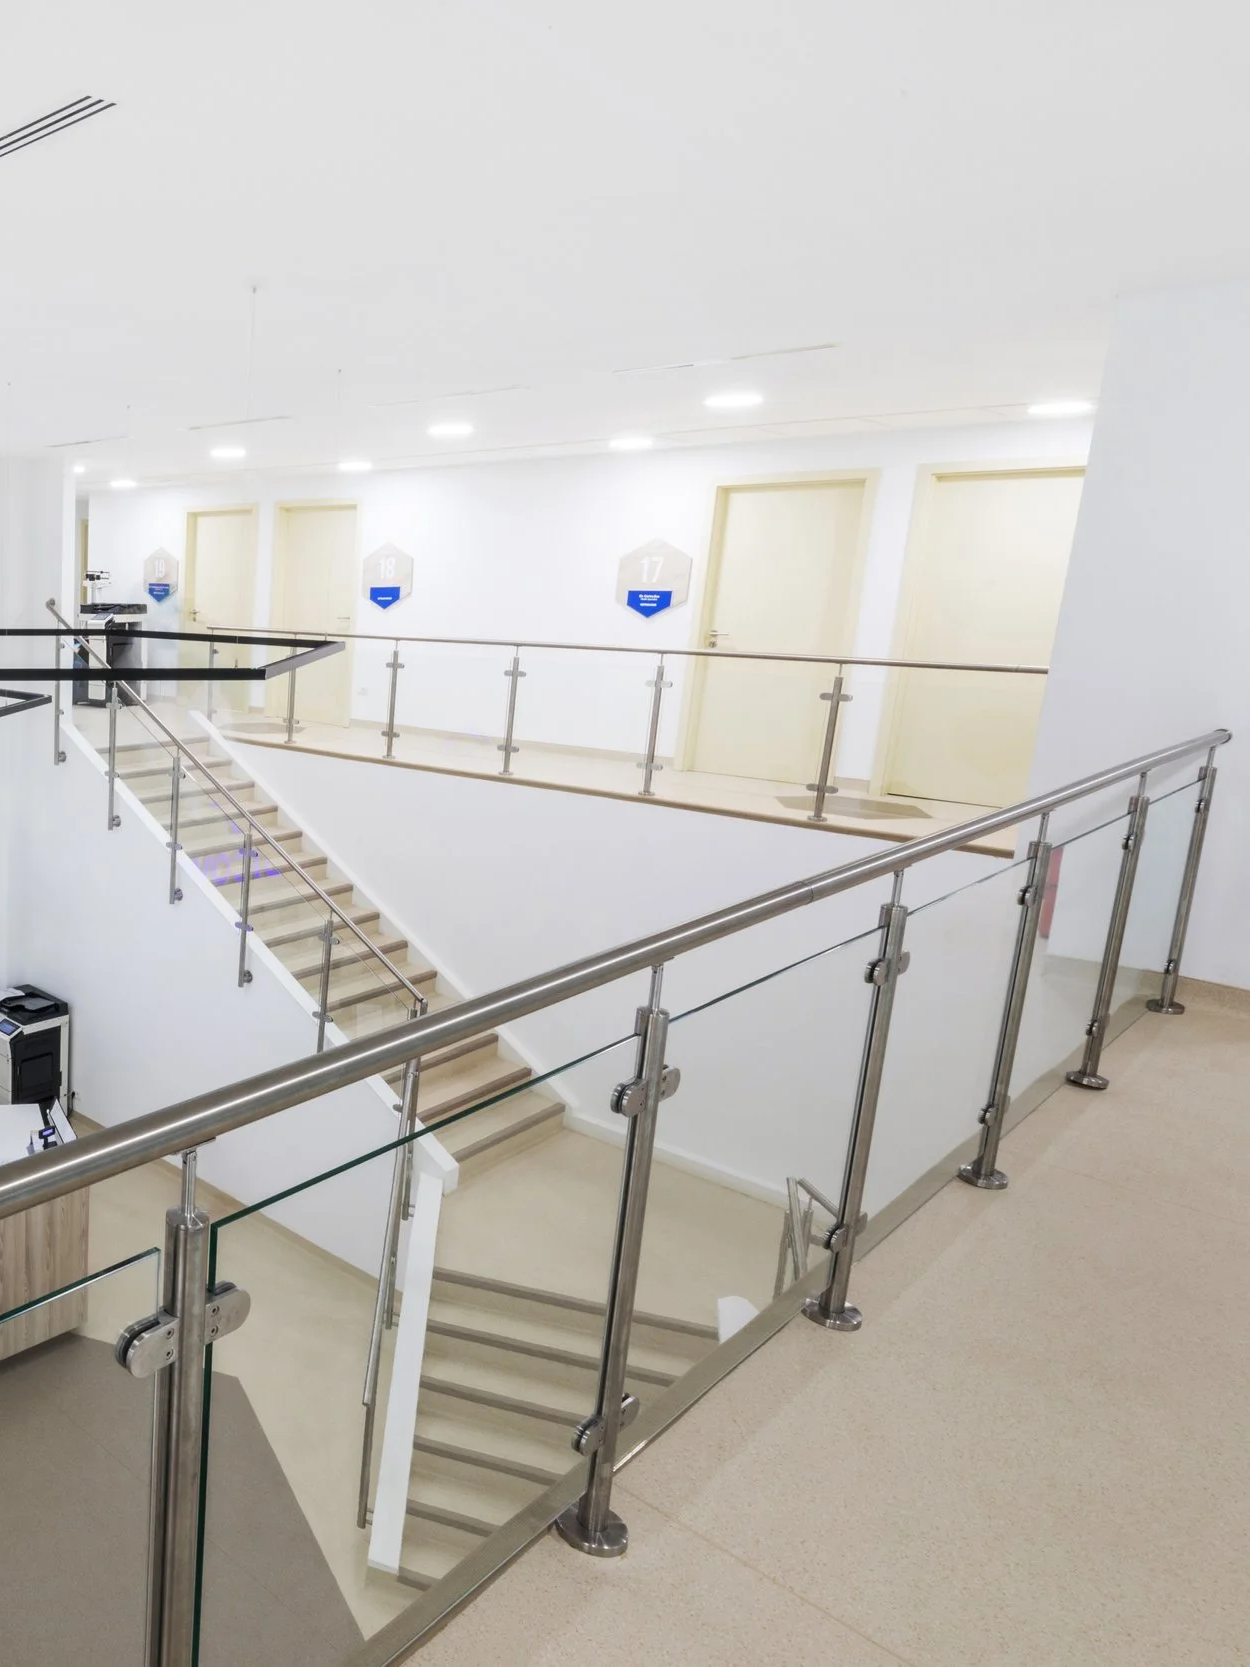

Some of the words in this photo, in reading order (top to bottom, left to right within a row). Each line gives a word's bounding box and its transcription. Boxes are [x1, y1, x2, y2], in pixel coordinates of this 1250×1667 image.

[154, 559, 166, 578] 19
[378, 556, 396, 579] 18
[640, 556, 664, 583] 17
